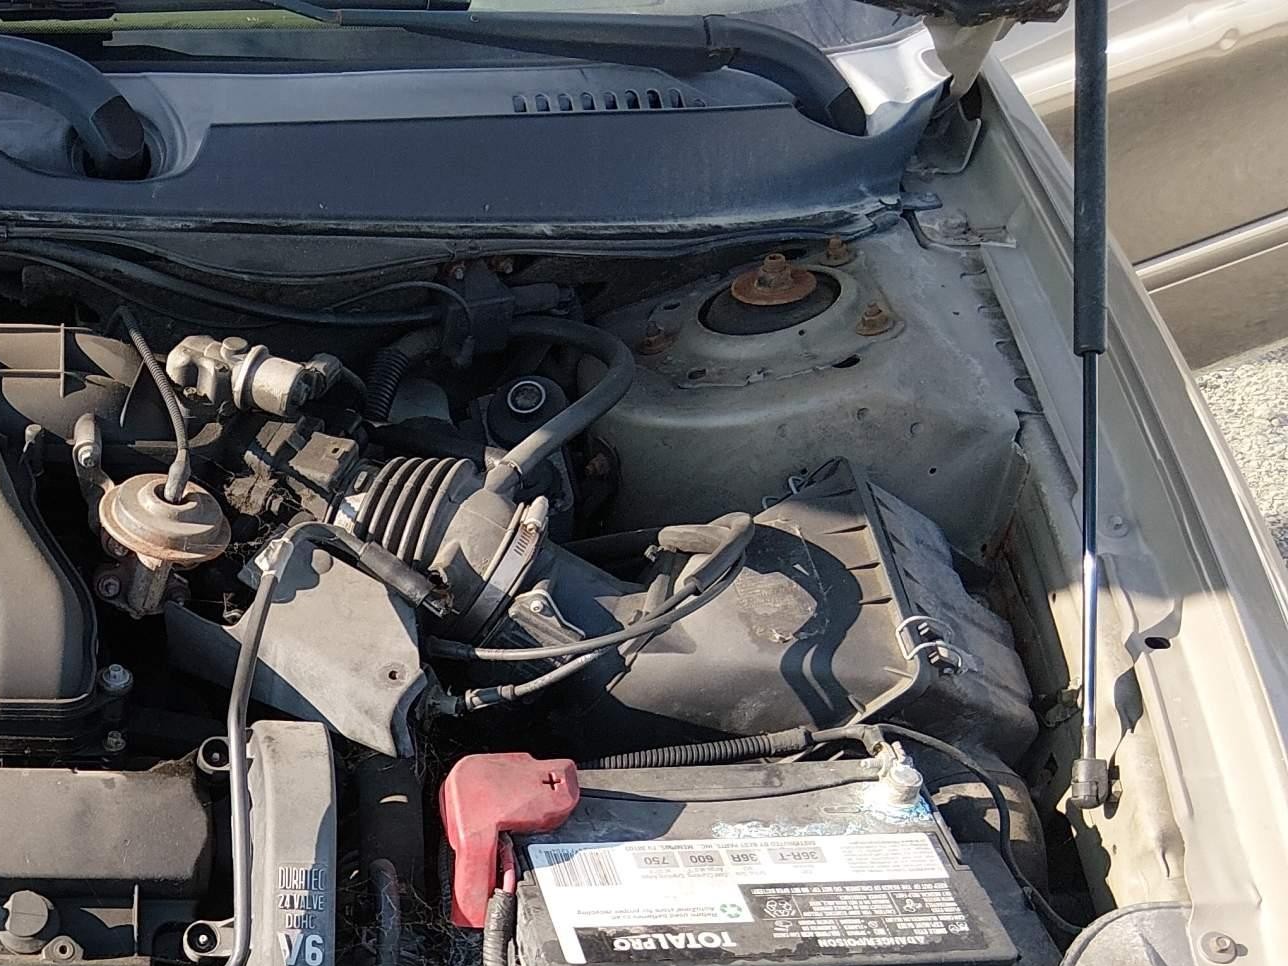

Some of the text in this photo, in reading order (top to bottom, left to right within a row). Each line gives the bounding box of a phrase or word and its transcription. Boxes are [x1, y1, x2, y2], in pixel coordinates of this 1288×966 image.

[644, 856, 669, 865] 750
[689, 854, 714, 864] 600
[730, 852, 758, 863] 36R
[778, 851, 819, 861] 36R-T
[278, 867, 326, 890] DURATEC
[278, 895, 324, 910] 24 VALVE
[285, 913, 316, 929] DOHC
[612, 931, 737, 951] TOTALPRO
[277, 932, 324, 966] V6
